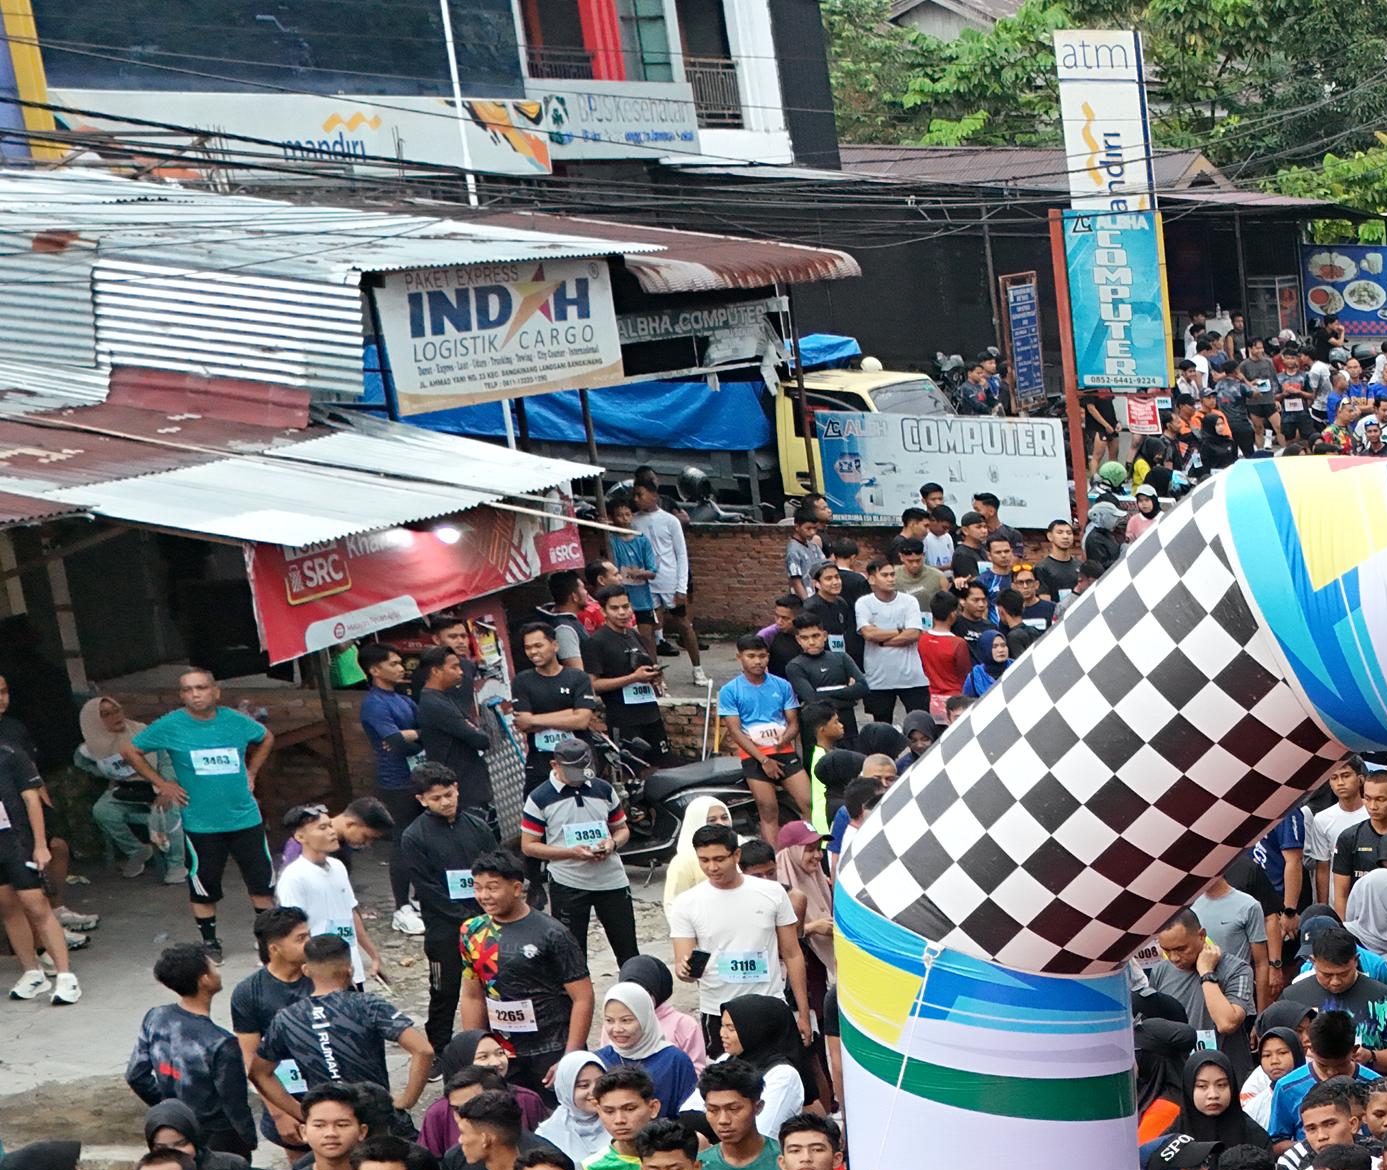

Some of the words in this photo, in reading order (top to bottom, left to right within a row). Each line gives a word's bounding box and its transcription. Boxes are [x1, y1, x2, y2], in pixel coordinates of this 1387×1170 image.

[1063, 43, 1128, 70] atm
[282, 132, 366, 163] mandiri
[1101, 132, 1129, 211] andiri
[405, 270, 449, 290] PAKET
[457, 264, 520, 285] EXPRESS
[1093, 231, 1139, 376] COMPUTER
[413, 334, 499, 362] LOGISTIK
[519, 324, 594, 350] CARGO
[901, 417, 1056, 457] COMPUTER
[554, 542, 581, 563] SRC
[303, 553, 344, 588] SRC
[731, 959, 757, 971] 3118
[495, 1009, 525, 1022] 2265
